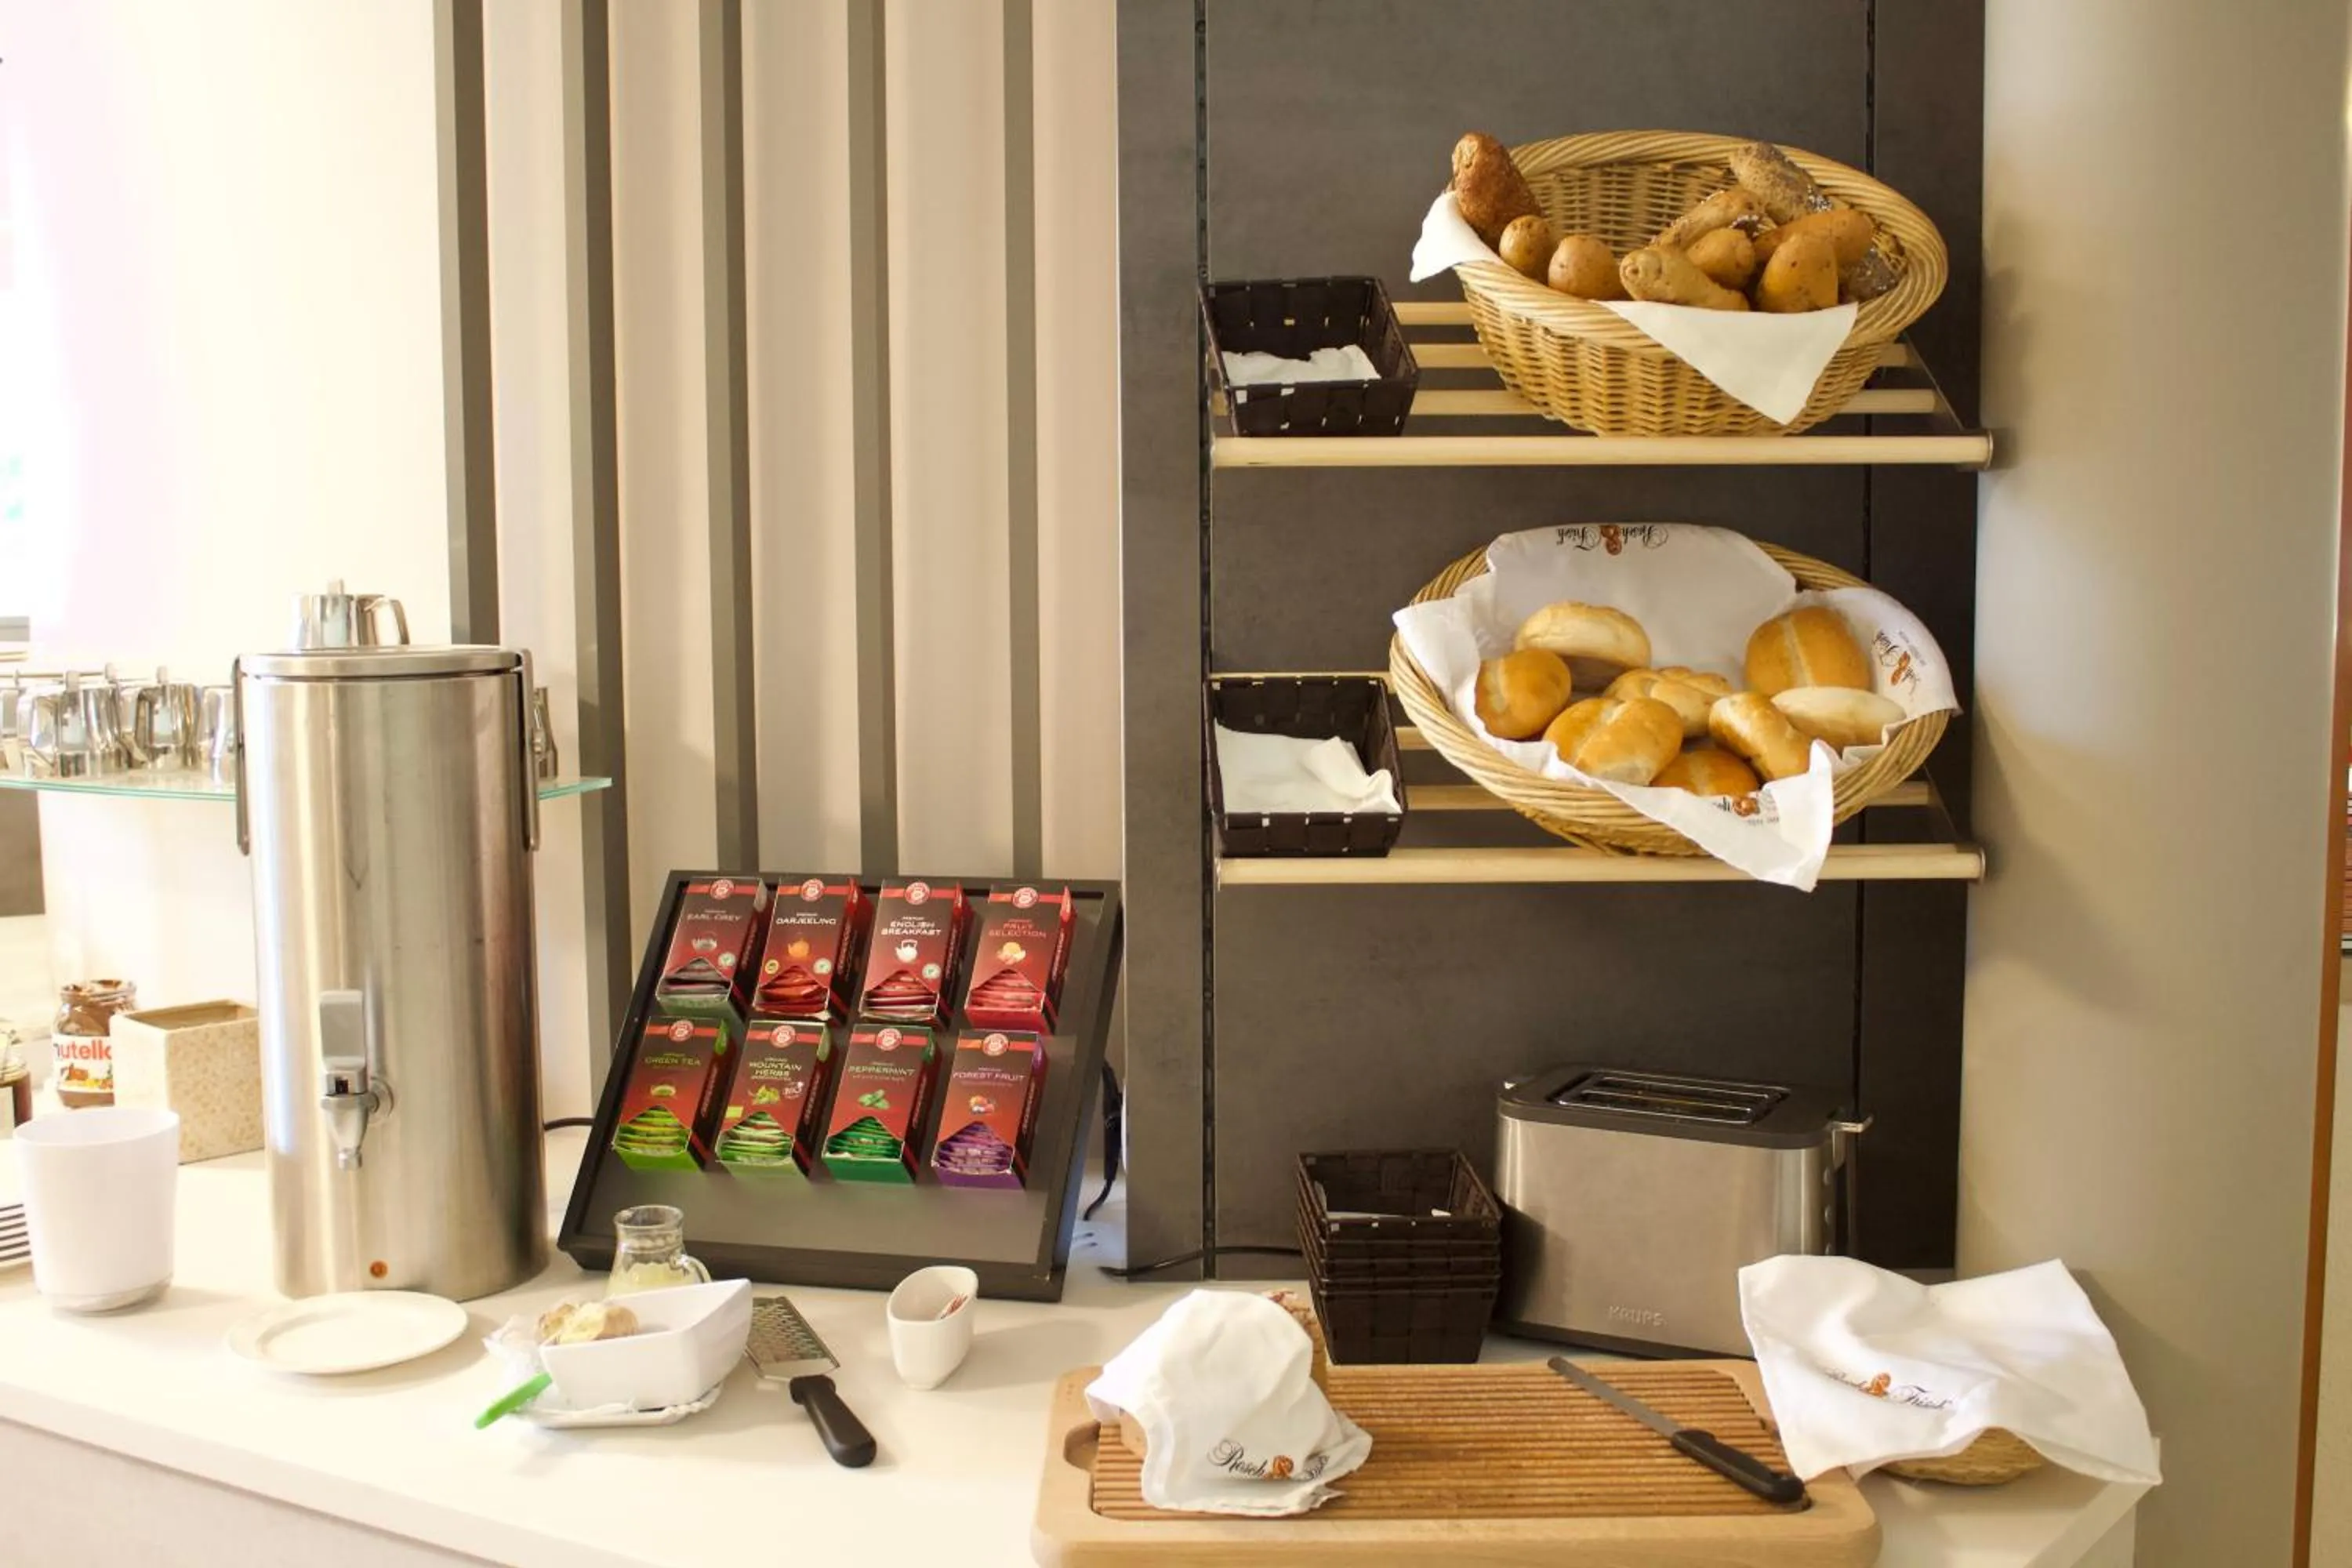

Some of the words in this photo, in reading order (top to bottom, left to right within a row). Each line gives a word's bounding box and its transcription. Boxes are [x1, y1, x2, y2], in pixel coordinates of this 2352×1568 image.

[713, 914, 742, 923] GREY
[775, 917, 837, 926] DARJEELING
[880, 927, 942, 936] BREAKFAST
[988, 929, 1047, 938] SELECTION
[681, 1057, 702, 1066] TEA
[749, 1062, 802, 1072] MOUNTAIN
[848, 1065, 916, 1077] PEPPERMINT
[953, 1071, 993, 1080] FOREST
[994, 1073, 1026, 1082] FRUIT
[1608, 1305, 1663, 1327] KRUPS
